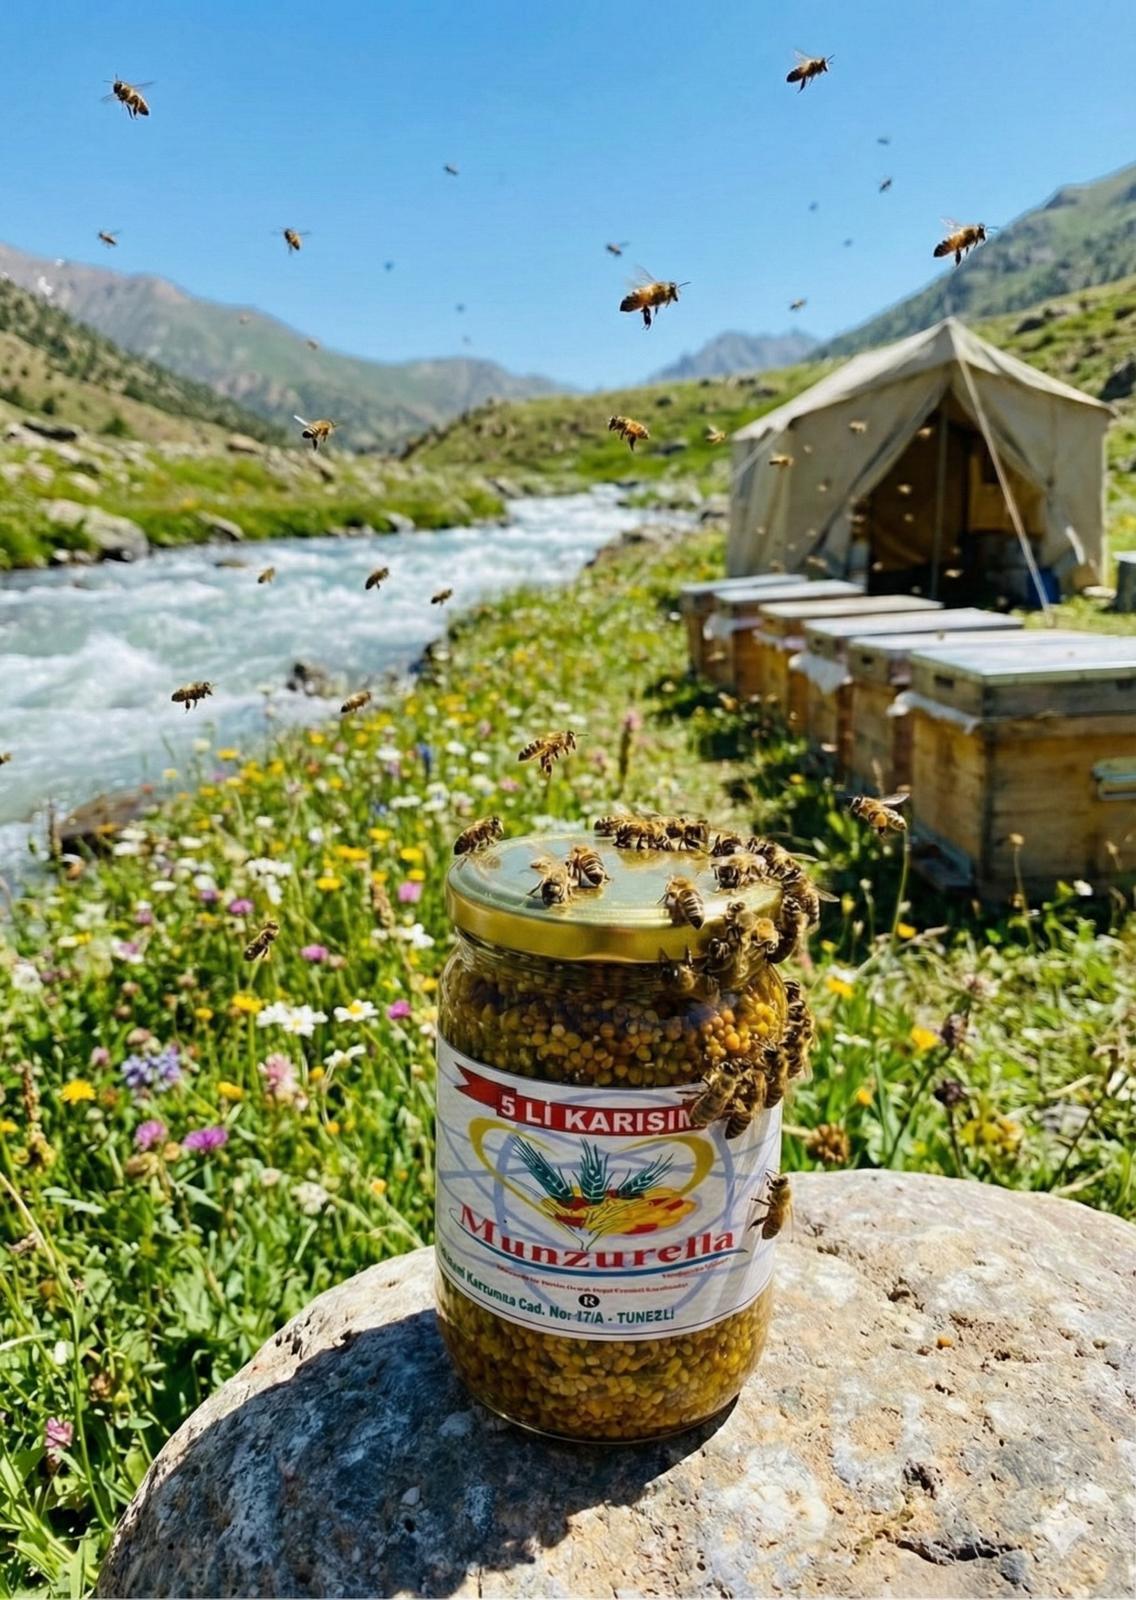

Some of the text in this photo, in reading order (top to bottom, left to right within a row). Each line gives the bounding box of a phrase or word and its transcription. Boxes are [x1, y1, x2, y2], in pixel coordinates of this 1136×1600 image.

[501, 1094, 515, 1117] 5
[460, 1203, 734, 1268] Munzurella
[519, 1297, 545, 1316] Cad.
